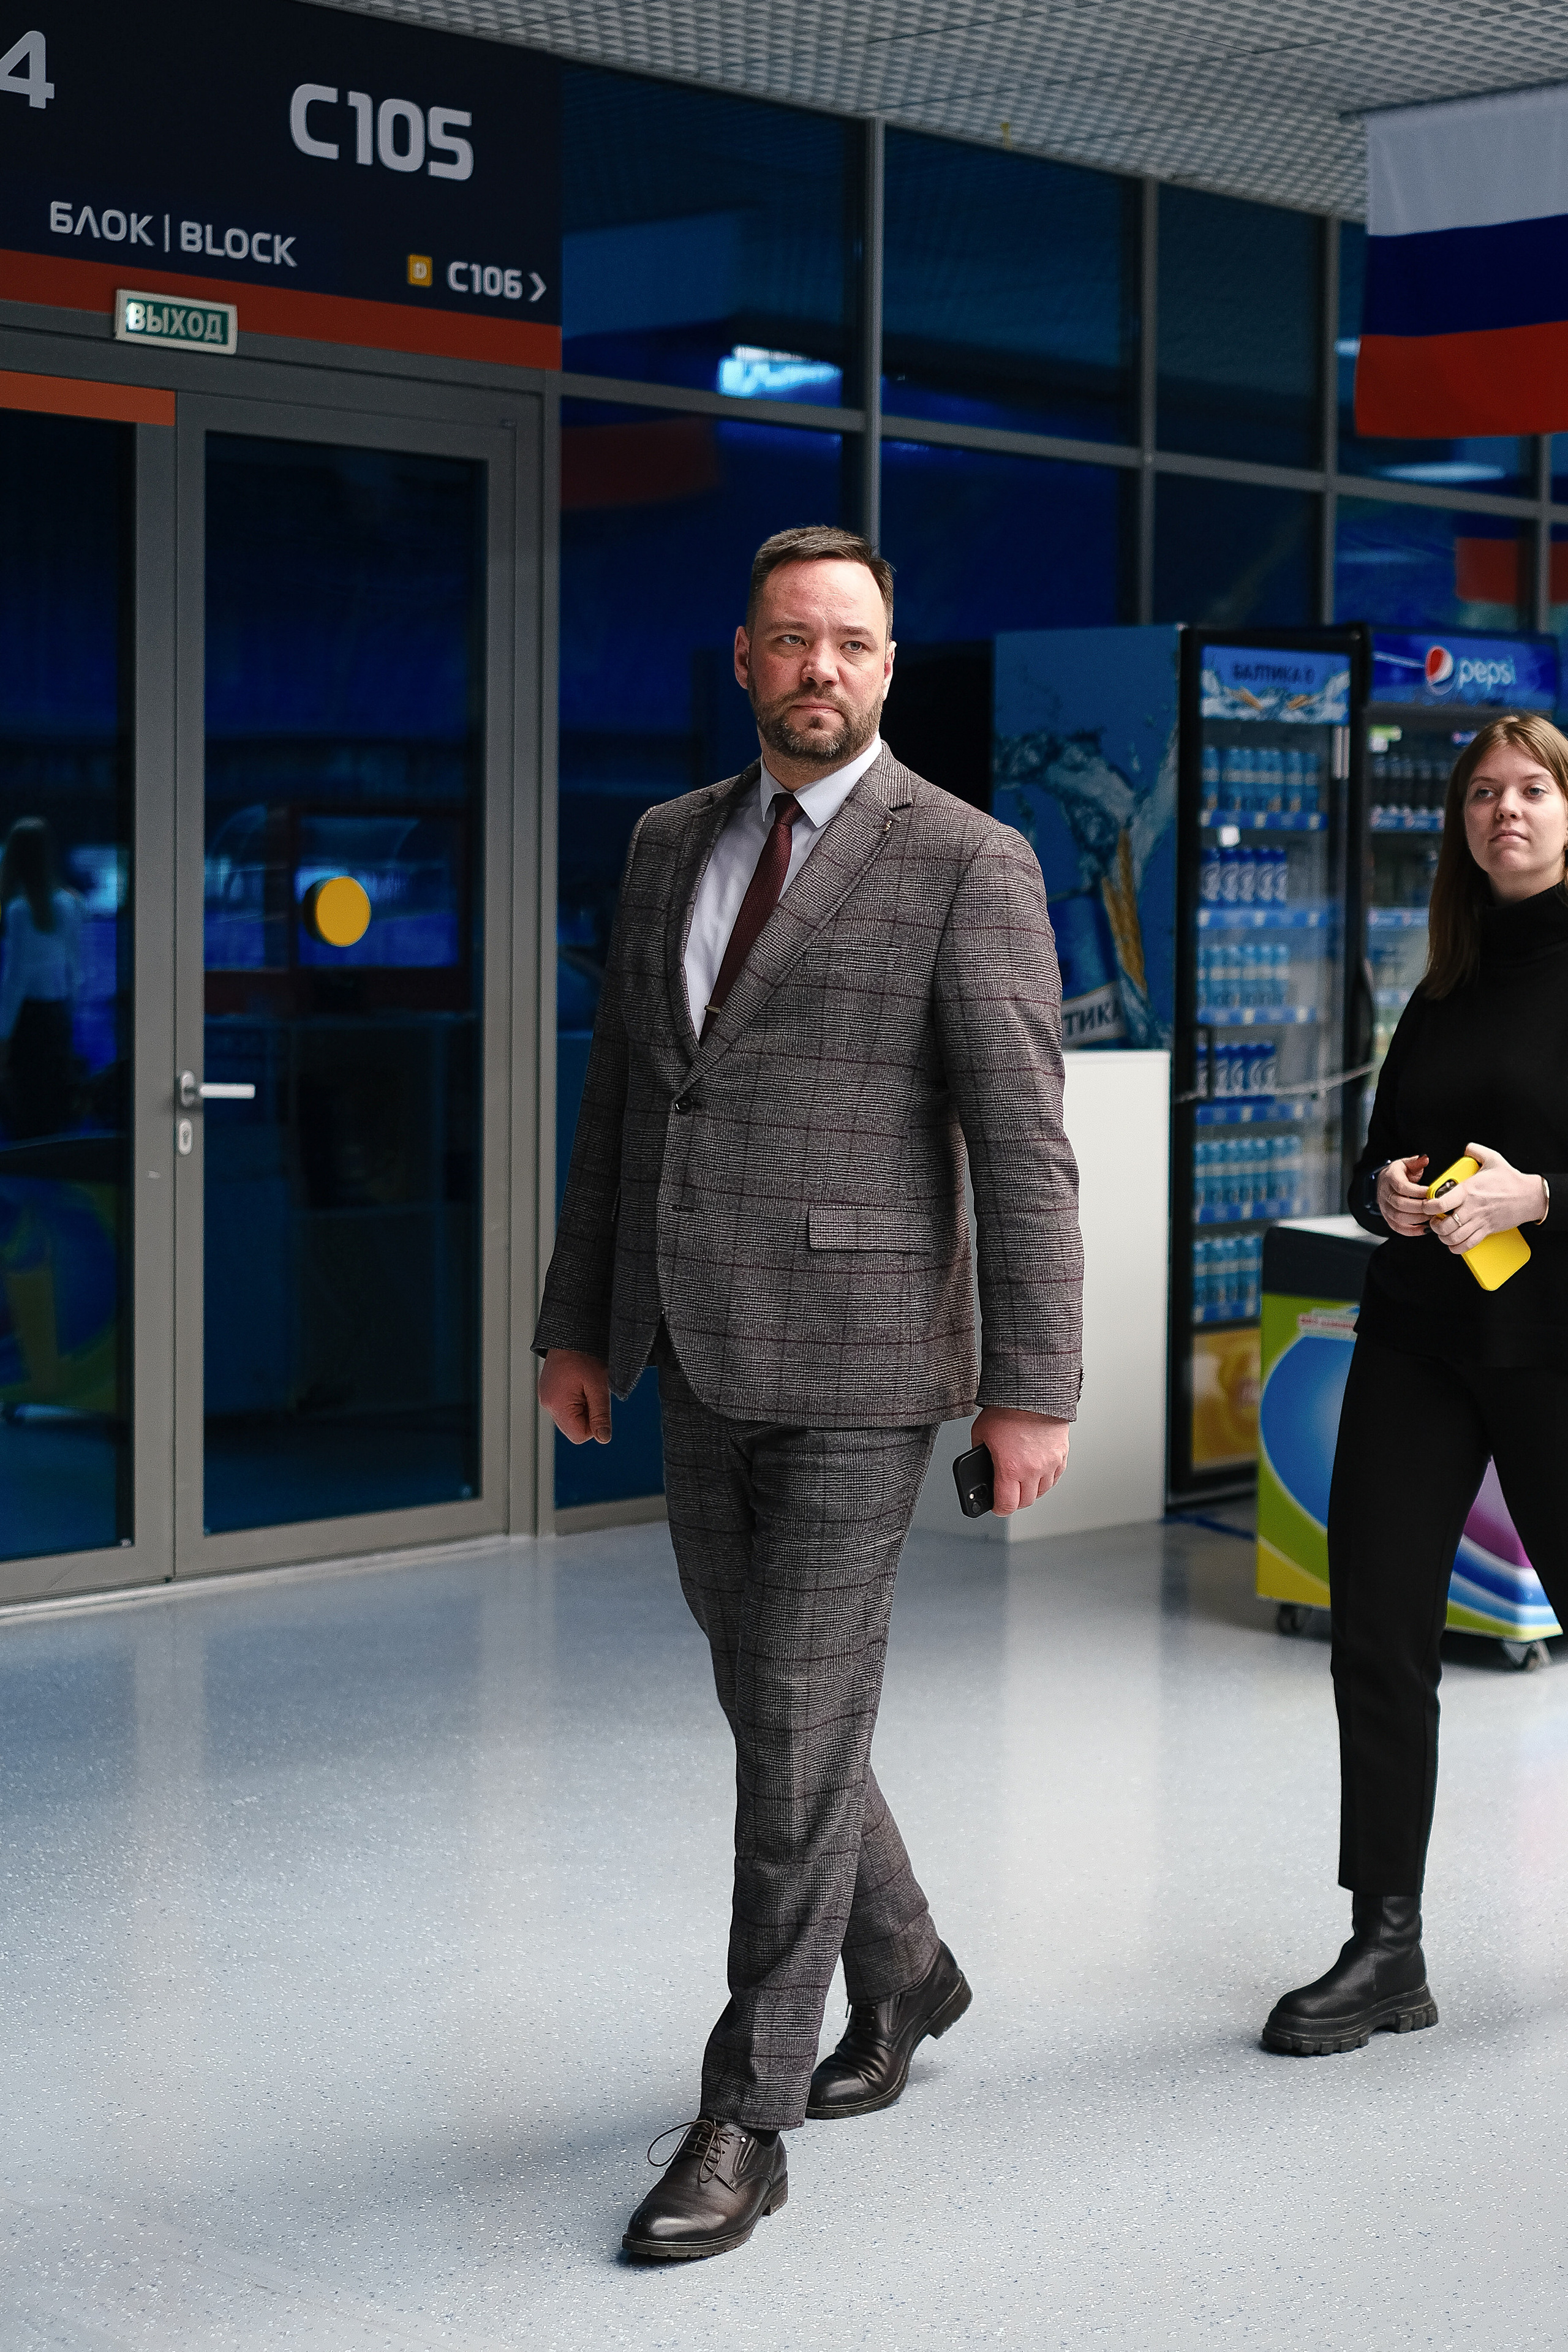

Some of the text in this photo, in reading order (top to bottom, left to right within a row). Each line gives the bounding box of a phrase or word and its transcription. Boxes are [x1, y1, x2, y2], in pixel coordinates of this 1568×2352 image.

[289, 83, 475, 181] C105
[50, 200, 298, 268] БЛОК BLOCK
[447, 261, 523, 300] C106
[126, 302, 223, 343] ВЫХОД
[1458, 655, 1515, 690] pepsi
